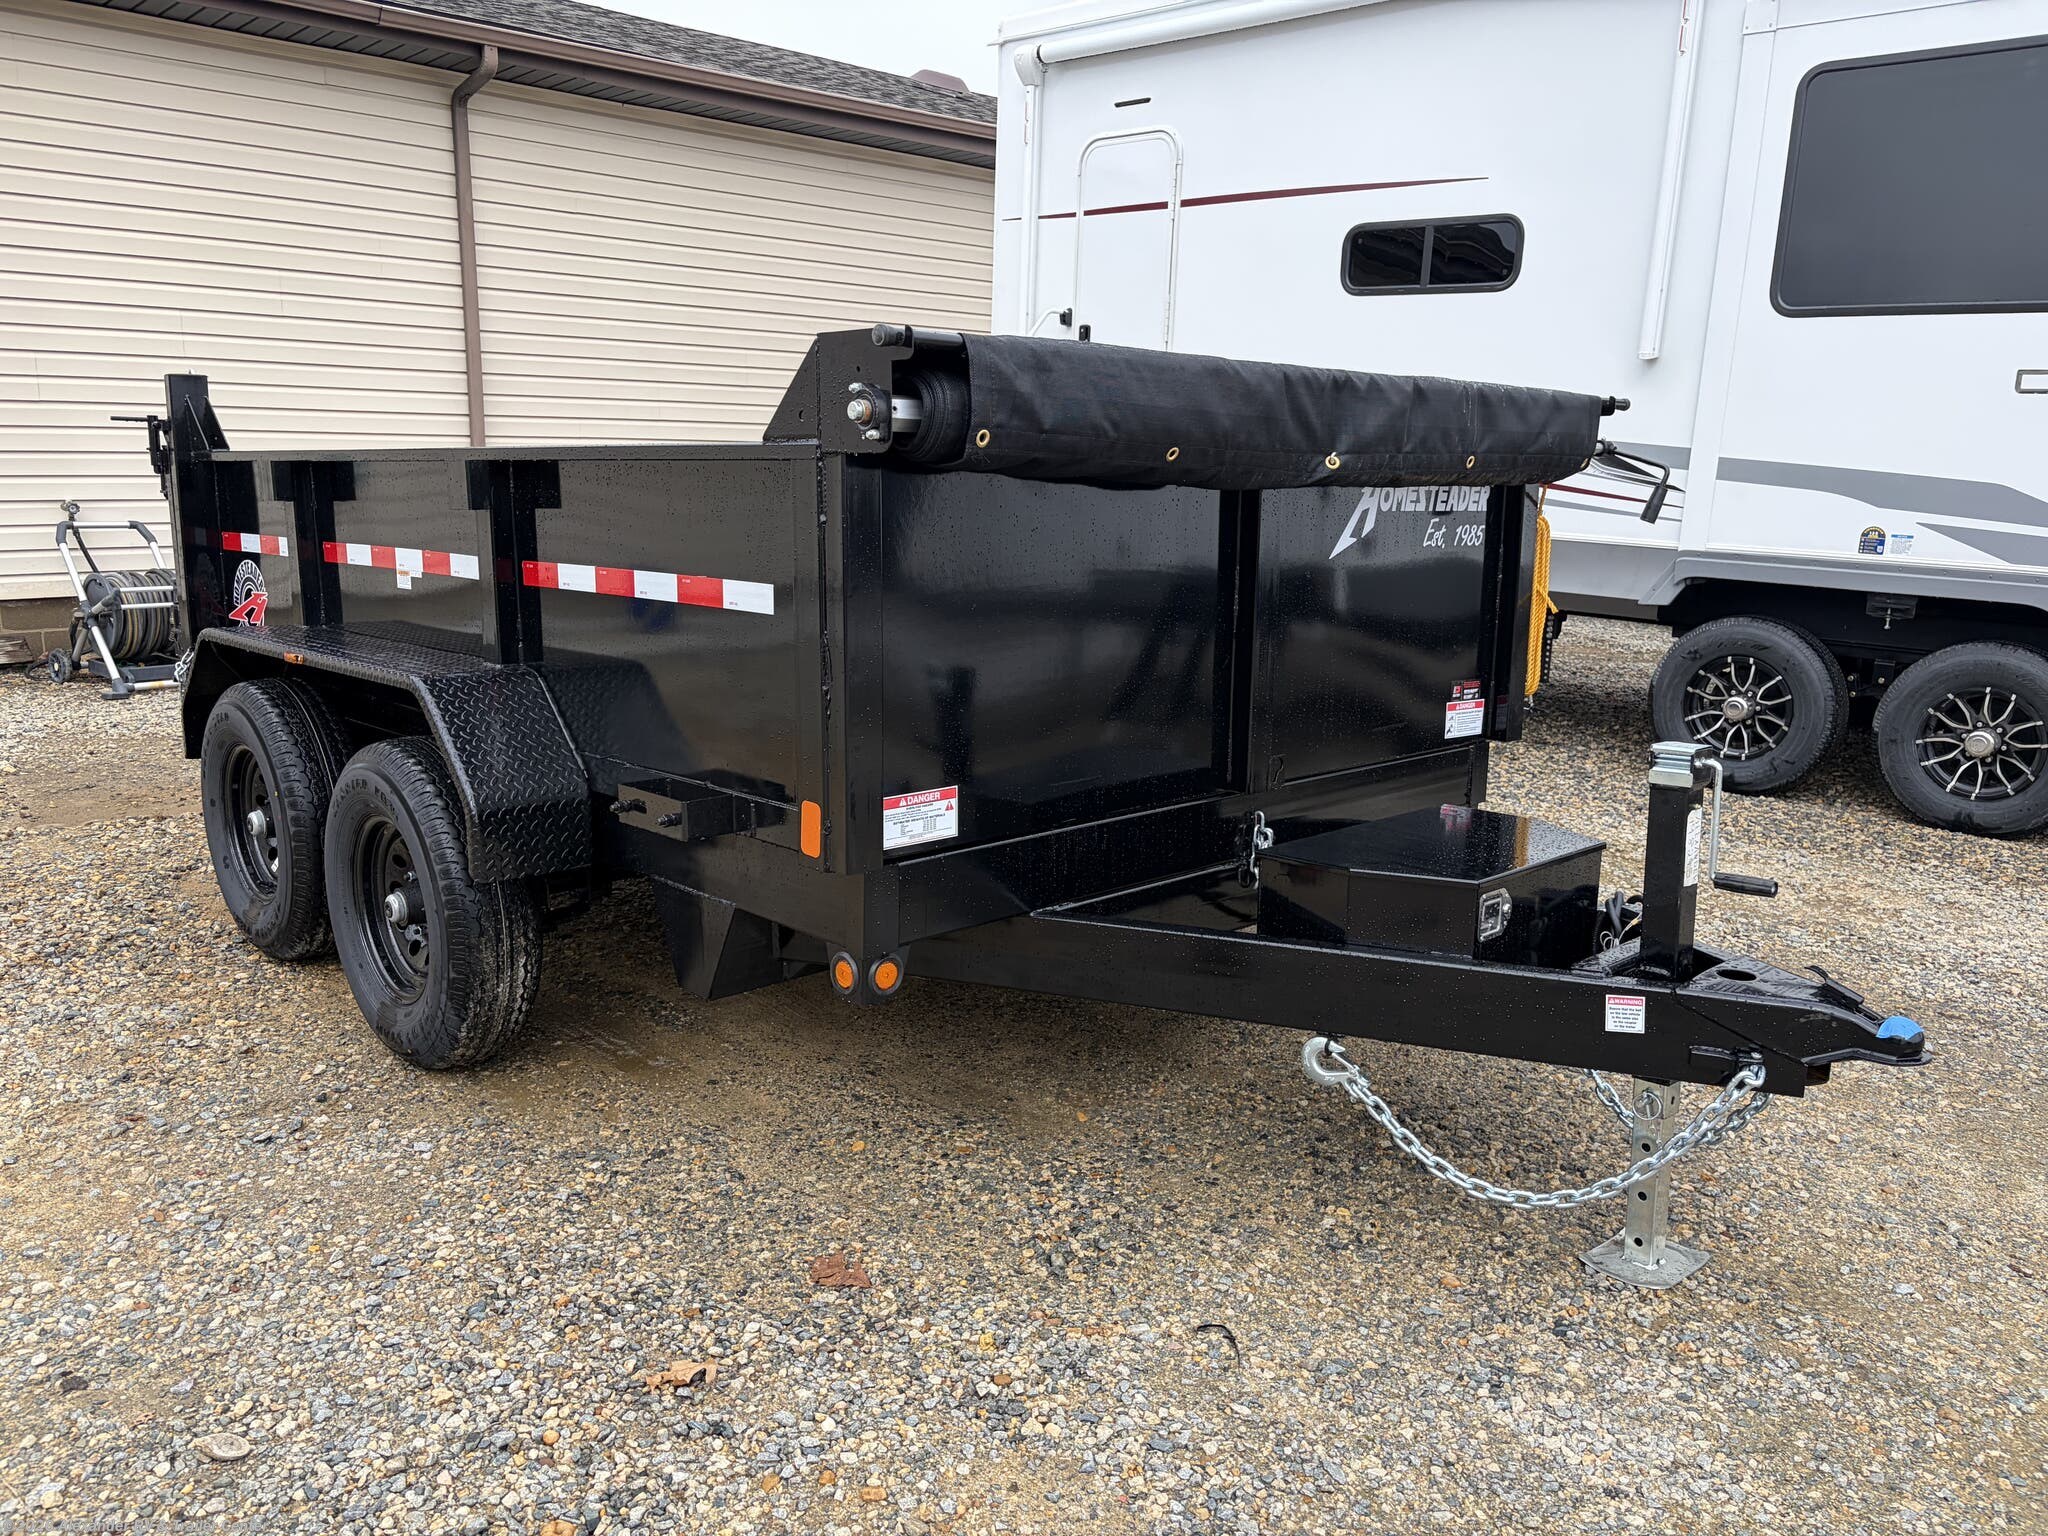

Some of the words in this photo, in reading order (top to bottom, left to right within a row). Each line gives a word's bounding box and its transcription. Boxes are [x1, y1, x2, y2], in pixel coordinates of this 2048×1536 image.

[1329, 486, 1491, 559] HOMESTEADER
[1453, 525, 1486, 547] 1985
[907, 792, 940, 804] DANGER
